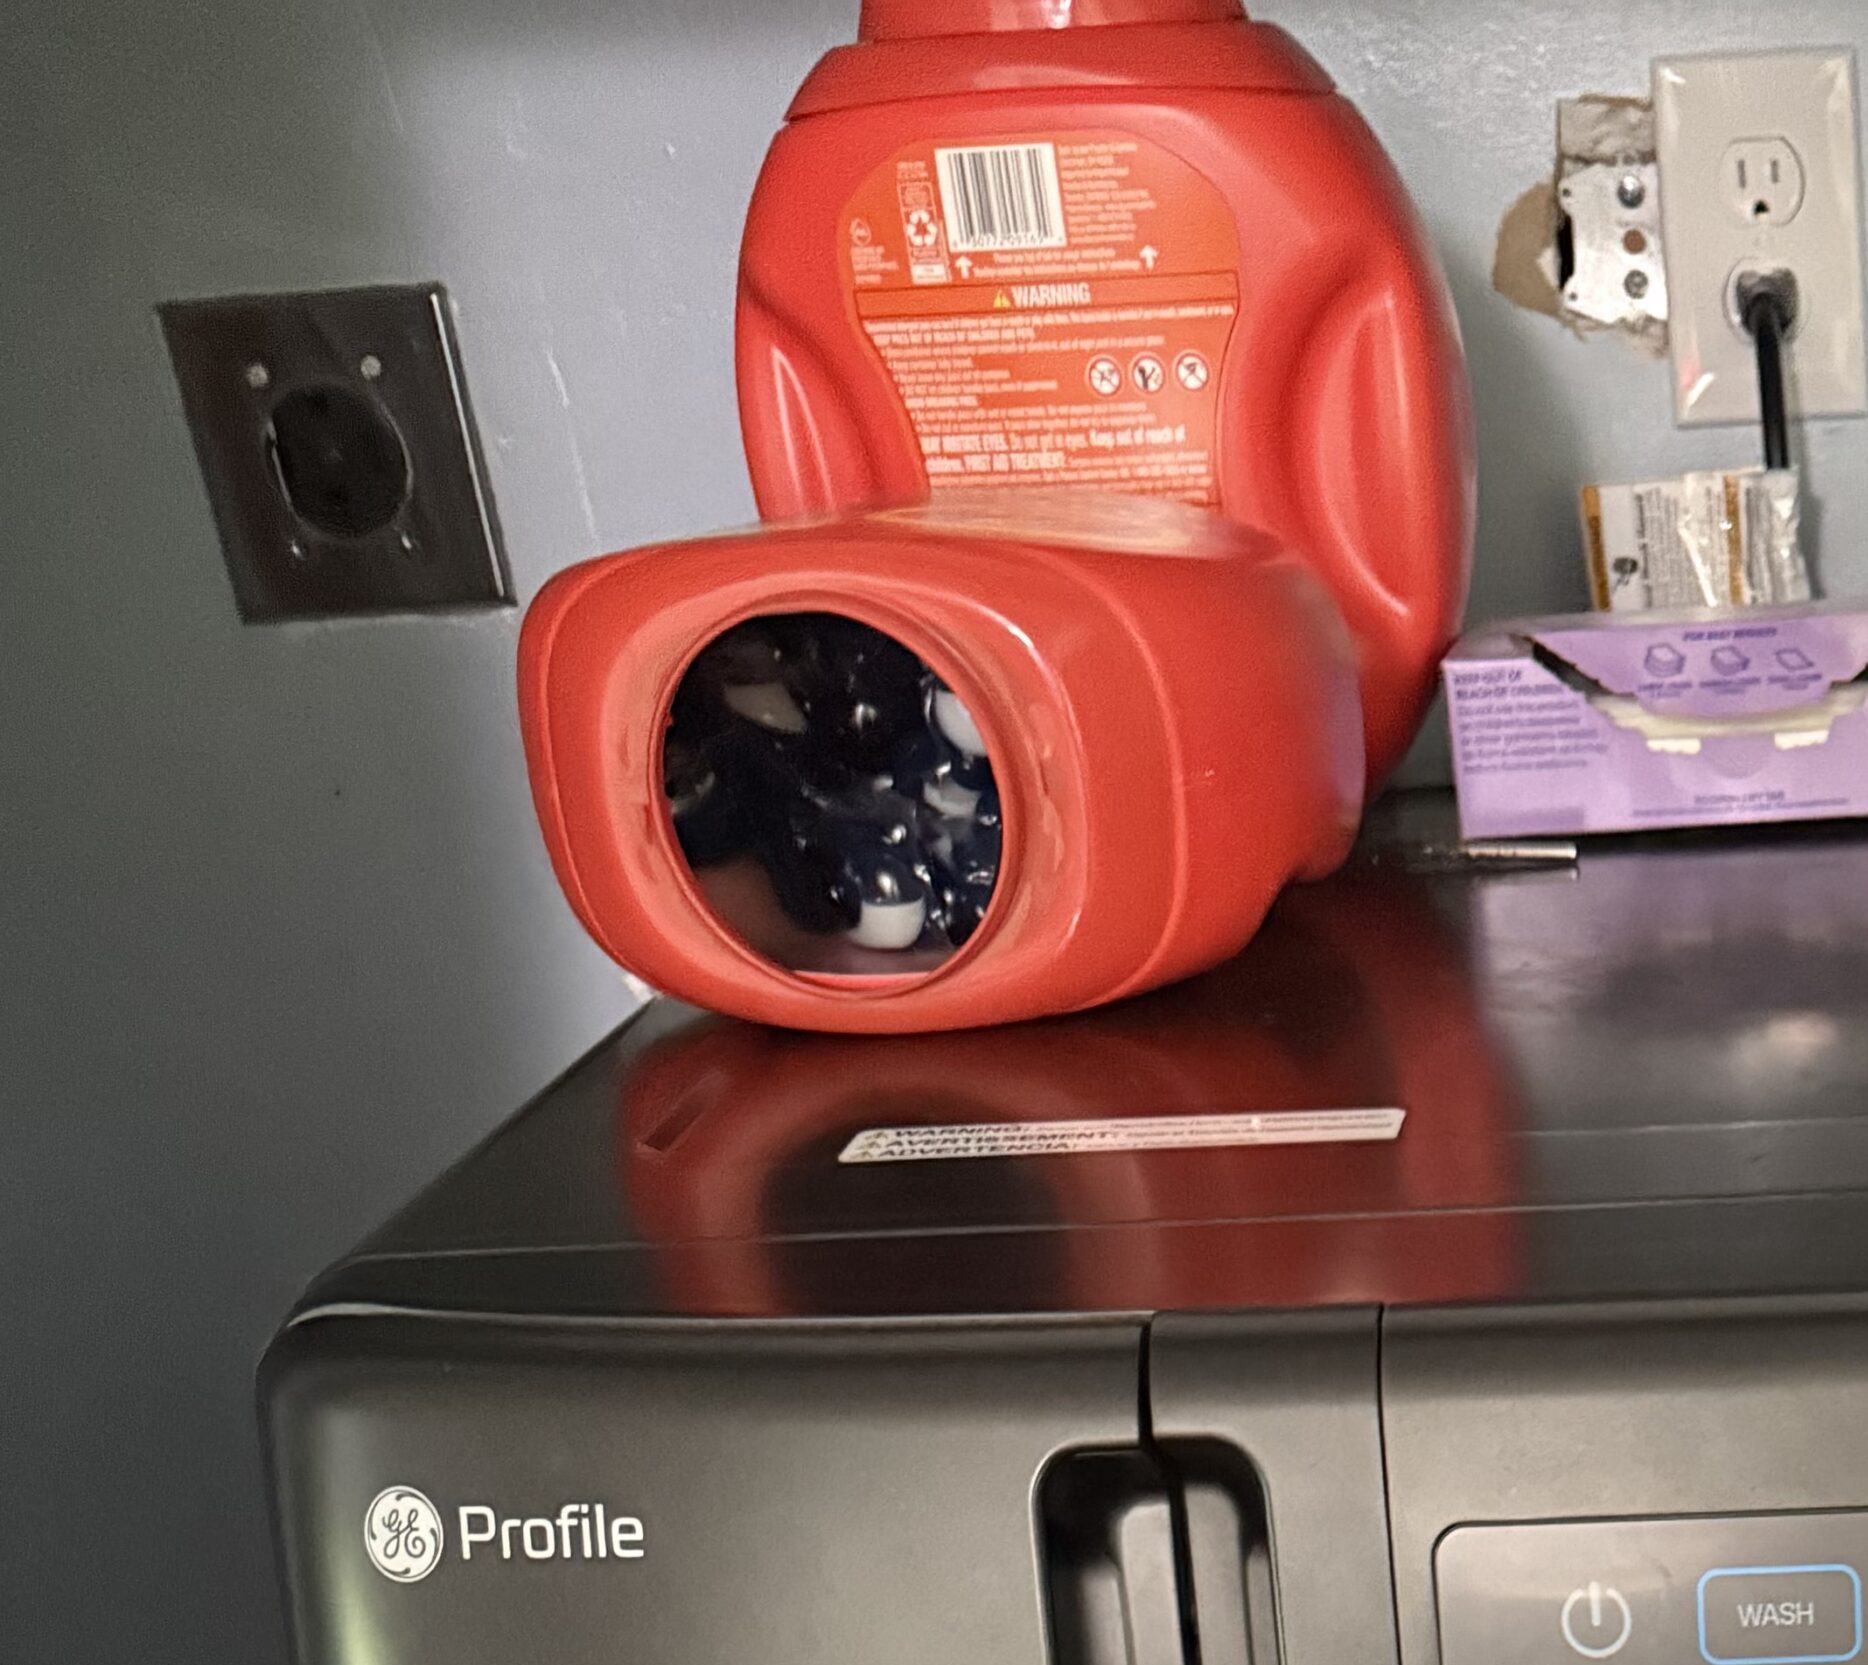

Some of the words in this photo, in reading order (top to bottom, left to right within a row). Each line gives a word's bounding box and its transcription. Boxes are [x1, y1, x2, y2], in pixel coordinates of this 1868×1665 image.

[1010, 281, 1093, 308] WARNING
[458, 1502, 645, 1561] Profile
[1737, 1601, 1816, 1629] WASH
